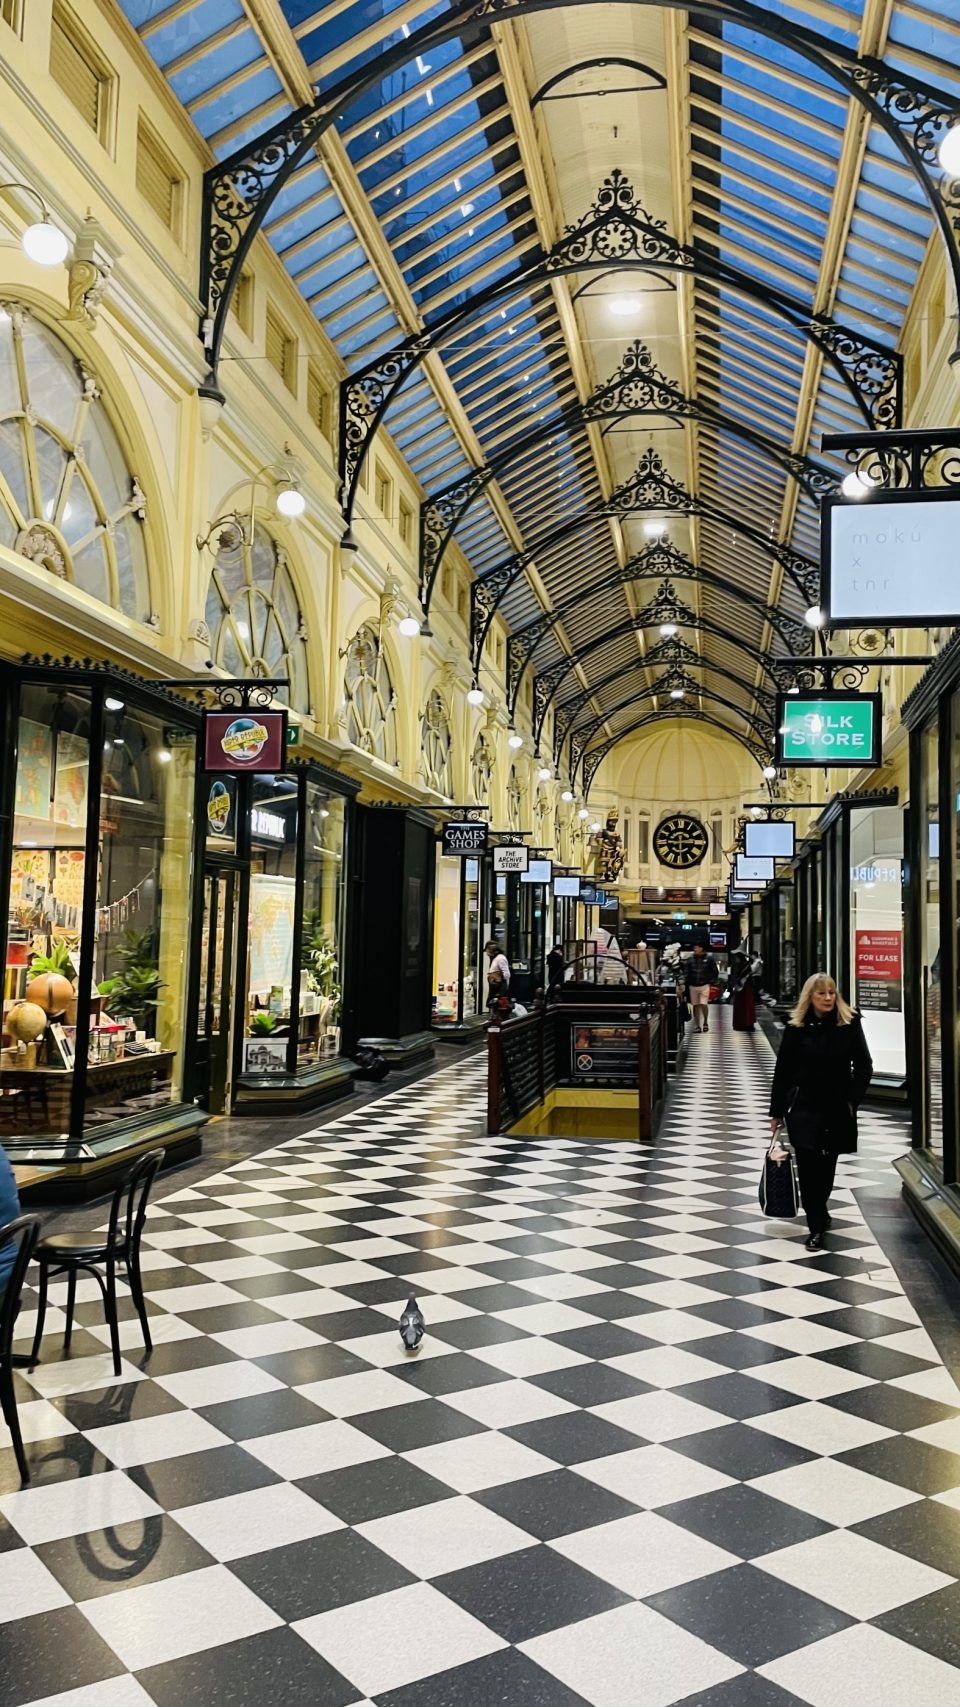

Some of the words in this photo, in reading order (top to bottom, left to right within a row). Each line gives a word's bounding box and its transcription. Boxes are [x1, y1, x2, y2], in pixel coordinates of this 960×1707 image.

[852, 525, 921, 544] mokú
[803, 713, 853, 728] SILK
[791, 730, 865, 746] STORE
[445, 830, 486, 840] GAMES
[449, 839, 480, 849] SHOP
